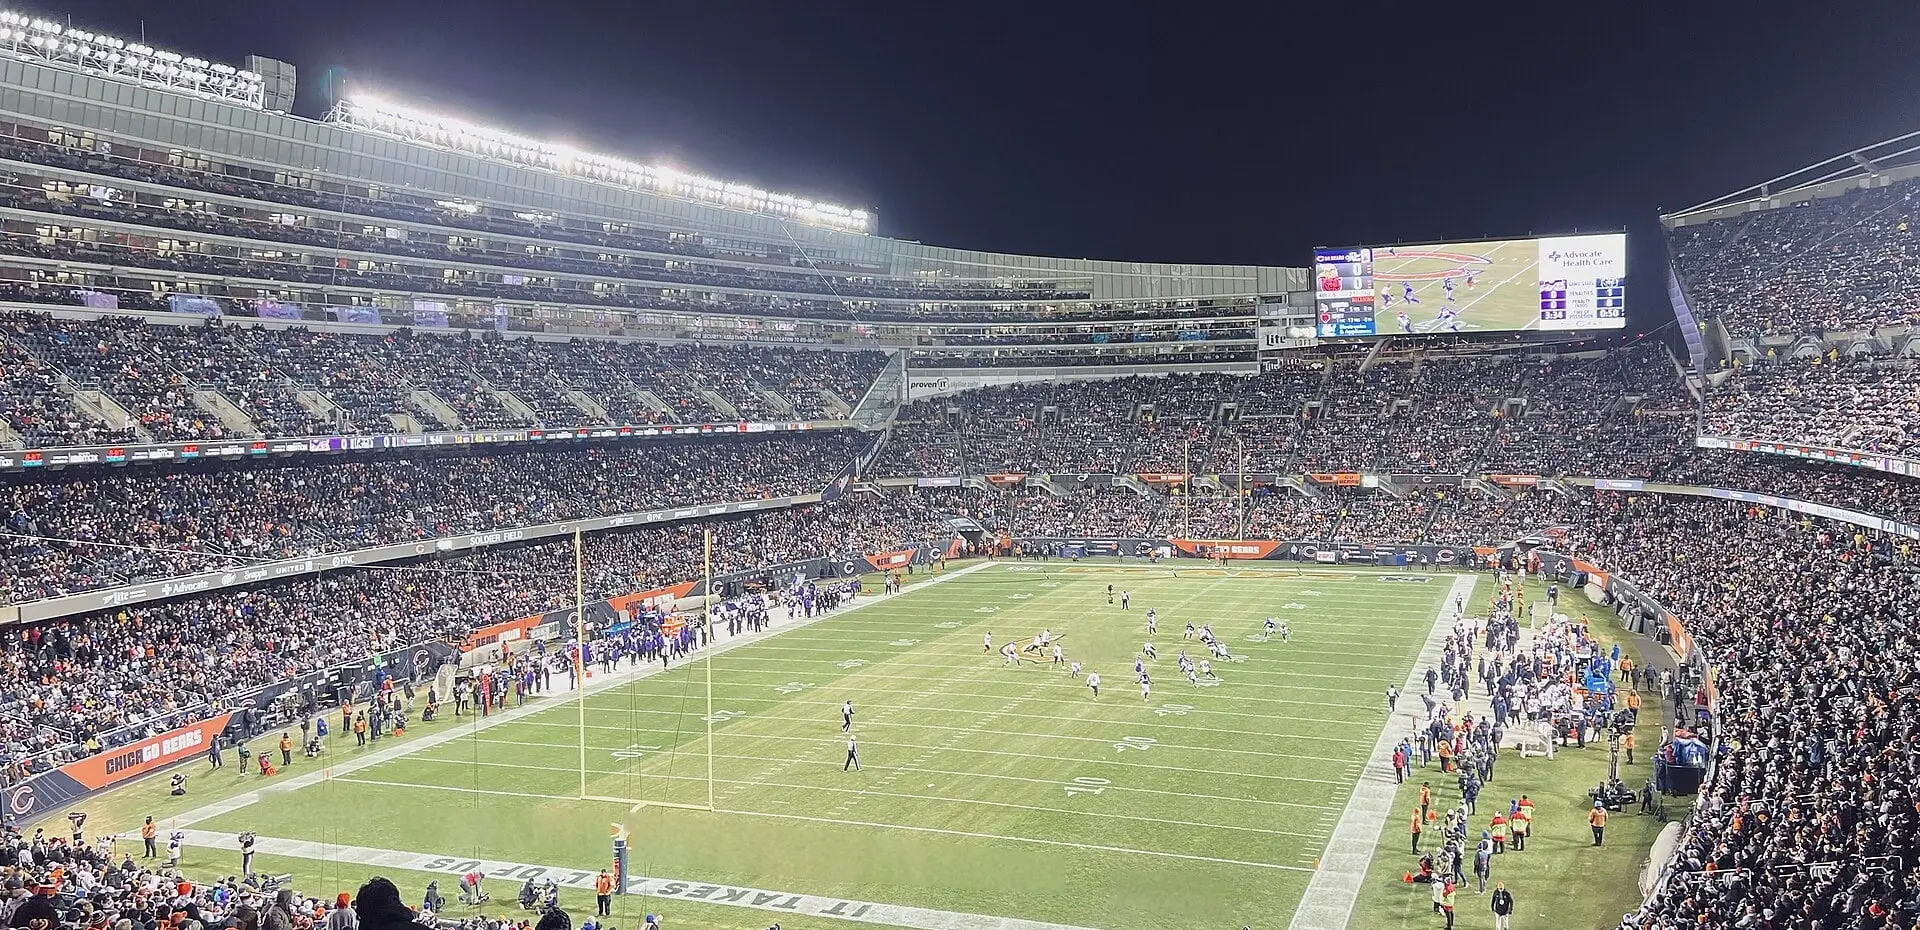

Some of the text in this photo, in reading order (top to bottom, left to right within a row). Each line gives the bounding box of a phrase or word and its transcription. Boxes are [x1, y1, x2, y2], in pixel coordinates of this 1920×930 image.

[1353, 264, 1361, 276] 0
[1354, 277, 1362, 290] 0
[1266, 335, 1286, 346] Lite
[911, 381, 937, 389] proven
[341, 439, 347, 450] 0
[384, 438, 390, 448] 0
[470, 530, 523, 546] SOLDIER FIELD
[341, 555, 355, 564] PNC
[276, 564, 305, 574] UNITED
[172, 580, 209, 595] Advocate
[105, 728, 203, 775] CHICAGO BEARS
[1113, 736, 1157, 753] 20
[610, 743, 662, 762] 10
[1064, 776, 1112, 797] 10
[424, 858, 481, 873] US
[489, 865, 548, 880] OF
[657, 882, 804, 910] TAKES
[819, 901, 868, 918] IT
